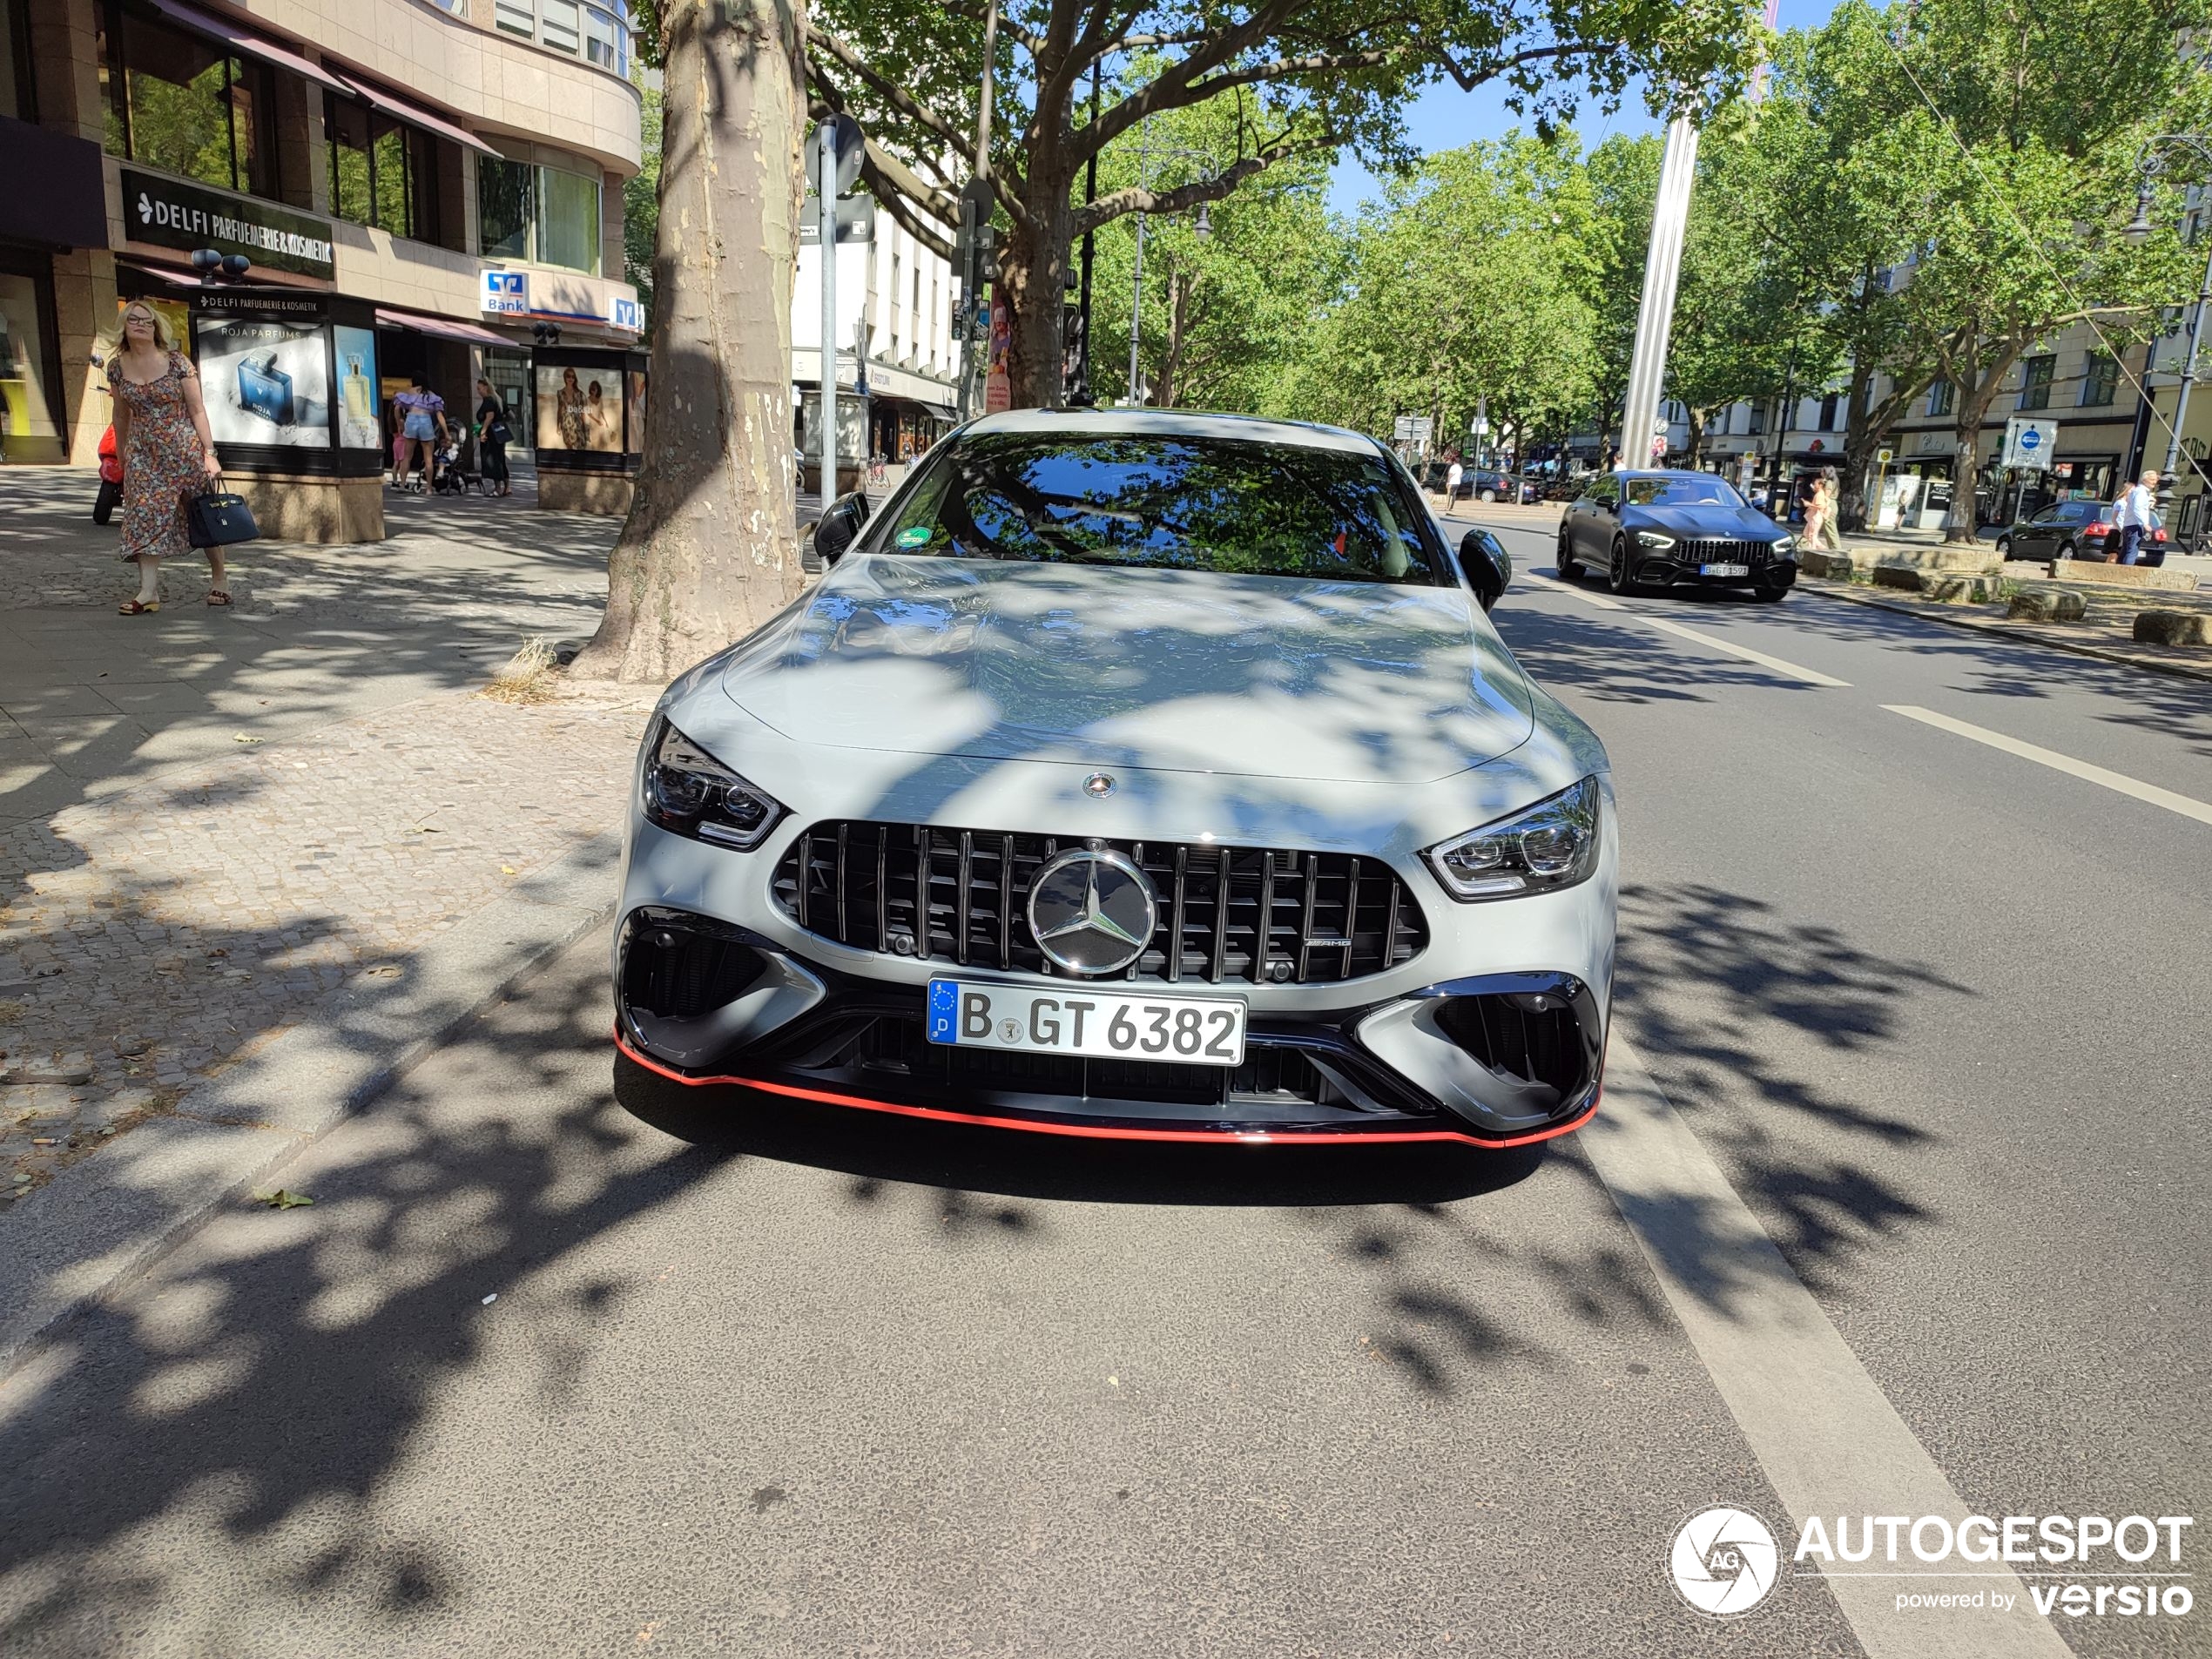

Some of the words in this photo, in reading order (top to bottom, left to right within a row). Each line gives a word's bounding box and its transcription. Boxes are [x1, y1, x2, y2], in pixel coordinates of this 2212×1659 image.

[155, 200, 208, 235] DELFI
[209, 297, 238, 307] DELFI
[489, 299, 523, 312] Bank
[221, 327, 248, 337] ROJA
[252, 328, 301, 340] PARFUMS
[252, 402, 272, 416] ROJA
[1716, 566, 1726, 575] GT
[937, 1018, 948, 1032] D
[961, 992, 993, 1039] B
[1029, 998, 1096, 1048] GT
[1107, 1004, 1236, 1057] 6382
